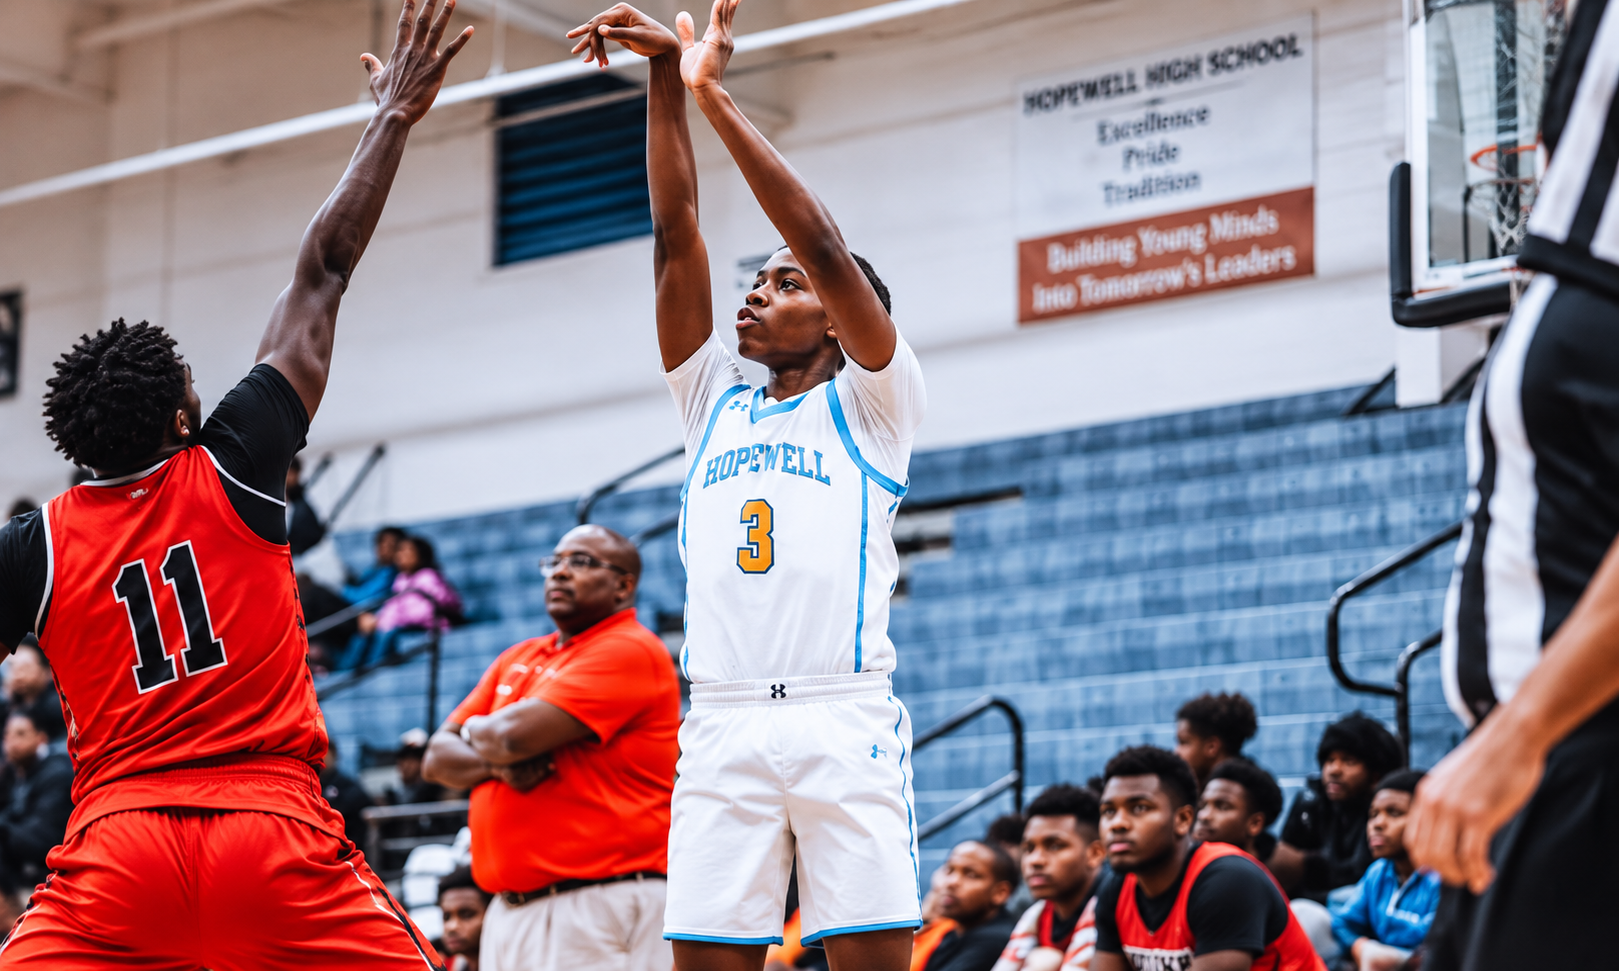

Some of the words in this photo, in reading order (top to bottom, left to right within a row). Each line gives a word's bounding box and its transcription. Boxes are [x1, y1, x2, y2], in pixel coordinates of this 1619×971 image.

[1023, 70, 1140, 116] HOPEWELL
[1145, 54, 1204, 90] HIGH
[1207, 33, 1304, 76] SCHOOL
[1097, 104, 1211, 146] Excellence
[1122, 139, 1180, 173] Pride
[1102, 170, 1202, 207] Tradition
[1047, 233, 1138, 274] Building
[1137, 219, 1207, 262] Young
[1209, 204, 1279, 244] Minds
[1032, 282, 1078, 314] Into
[1076, 256, 1204, 306] Tomorrow's
[1205, 243, 1297, 284] Leaders
[702, 442, 832, 489] HOPEWELL
[736, 498, 775, 575] 3
[111, 539, 229, 695] 11
